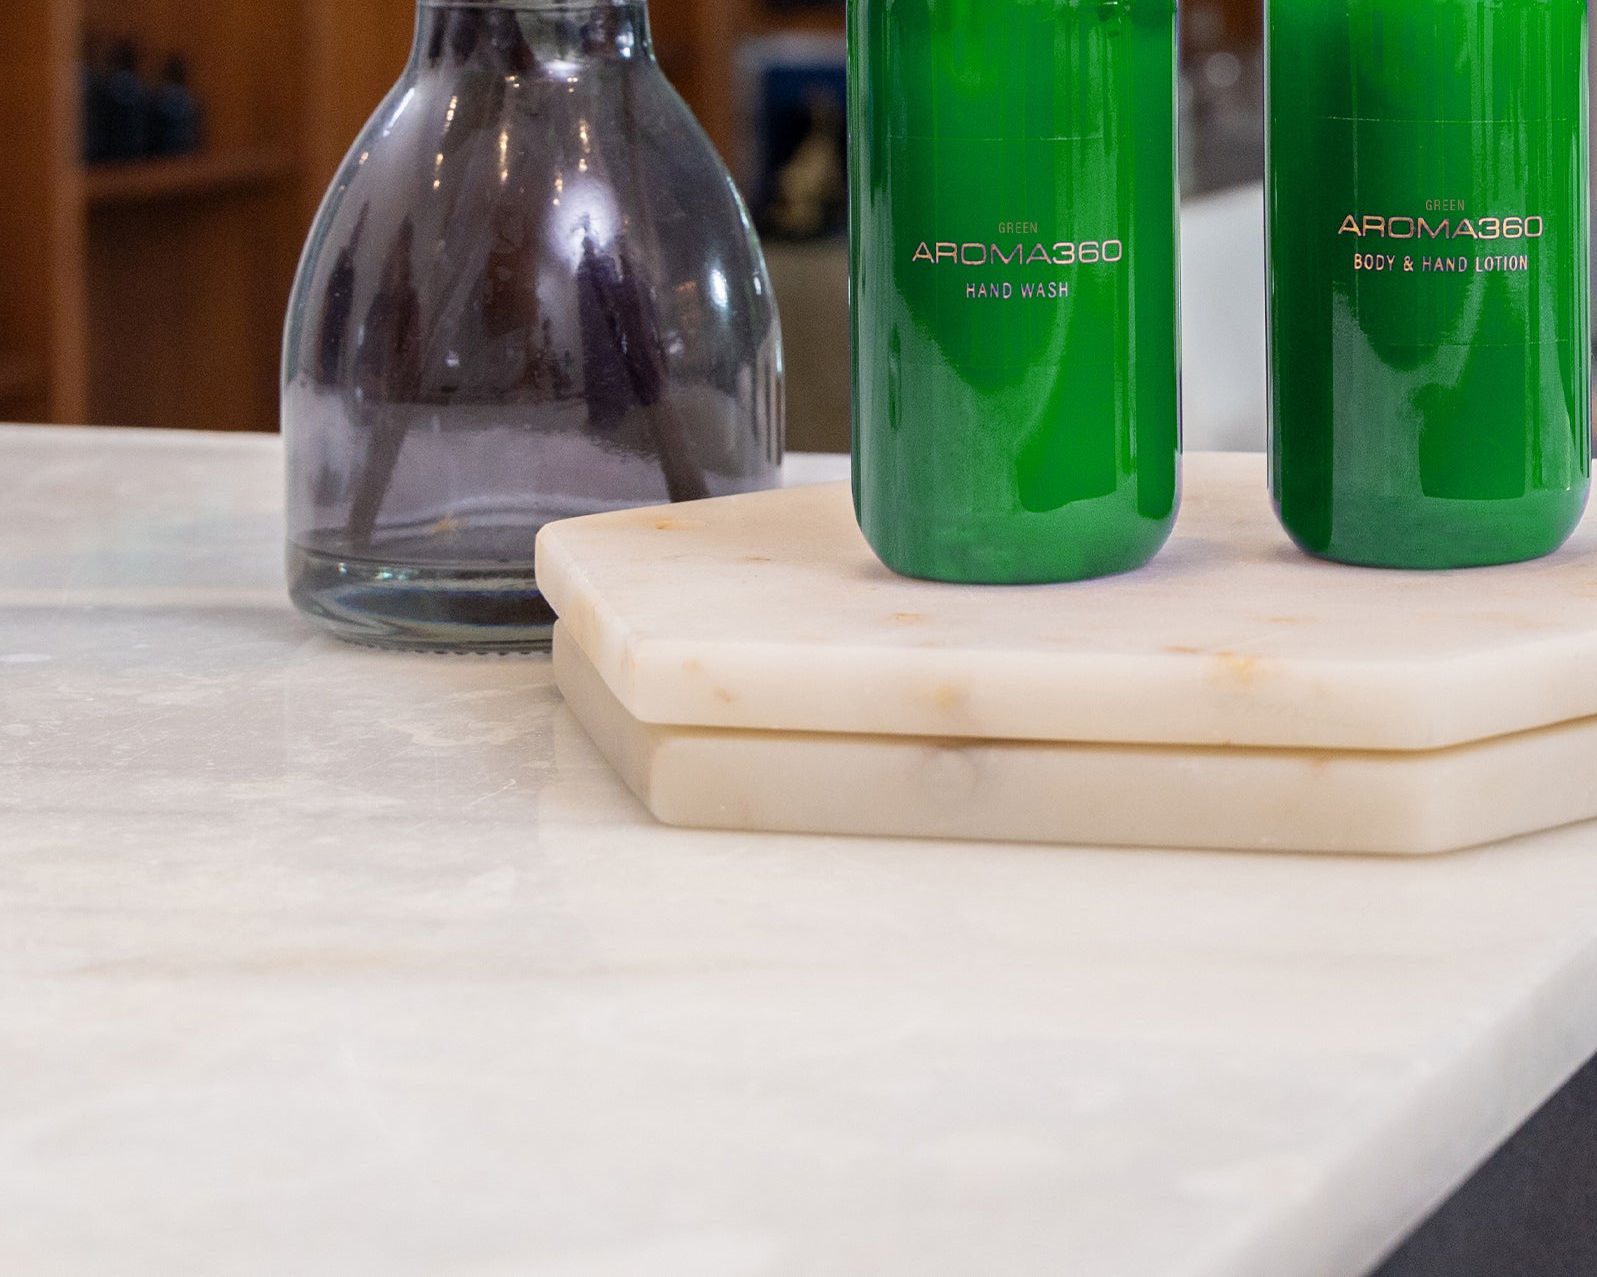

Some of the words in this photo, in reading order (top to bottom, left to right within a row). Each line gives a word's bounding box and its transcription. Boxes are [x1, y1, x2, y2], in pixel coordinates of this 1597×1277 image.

[1425, 199, 1465, 211] GREEN
[998, 222, 1038, 234] GREEN
[1338, 214, 1543, 240] AROMA360
[912, 239, 1123, 265] AROMA360
[1354, 253, 1396, 271] BODY
[1403, 255, 1414, 272] &
[1422, 256, 1468, 273] HAND
[1475, 255, 1528, 273] LOTION
[966, 283, 1013, 299] HAND
[1021, 282, 1069, 299] WASH
